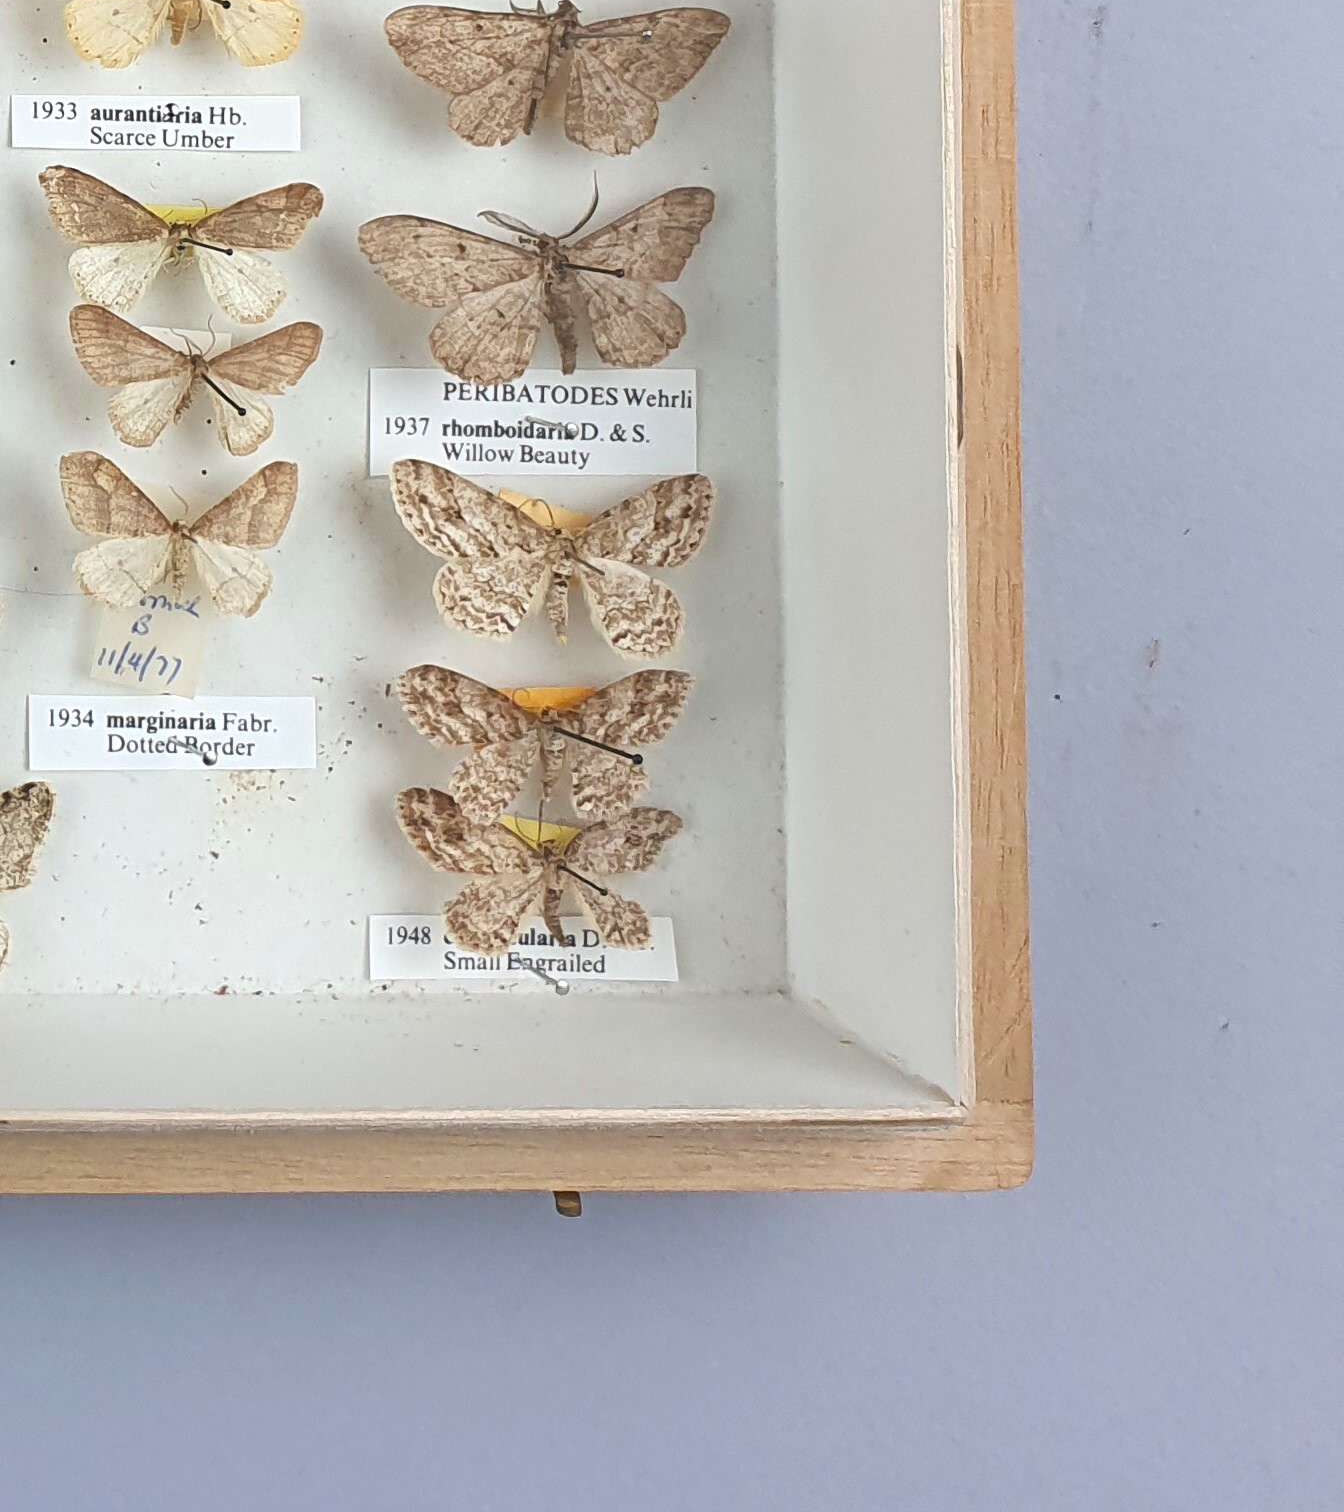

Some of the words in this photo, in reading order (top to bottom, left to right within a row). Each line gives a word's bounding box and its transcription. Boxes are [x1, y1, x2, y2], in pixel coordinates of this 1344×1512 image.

[32, 101, 77, 120] 1933
[209, 106, 247, 126] Hb.
[91, 126, 156, 146] Scarce
[162, 128, 235, 149] Umber
[443, 382, 619, 406] PERIBATODES
[625, 387, 693, 410] Wehrli
[385, 416, 430, 436] 1937
[580, 422, 605, 442] D.
[610, 423, 628, 442] &
[632, 423, 650, 443] S.
[442, 442, 514, 463] Willow
[520, 444, 590, 470] Beauty
[48, 708, 94, 728] 1934
[106, 711, 216, 737] marginaria
[222, 712, 278, 734] Fabr.
[107, 734, 178, 754] Dotted
[183, 736, 255, 757] Border
[388, 925, 432, 946] 1948
[443, 951, 501, 971] Small
[507, 952, 606, 974] Engrailed
